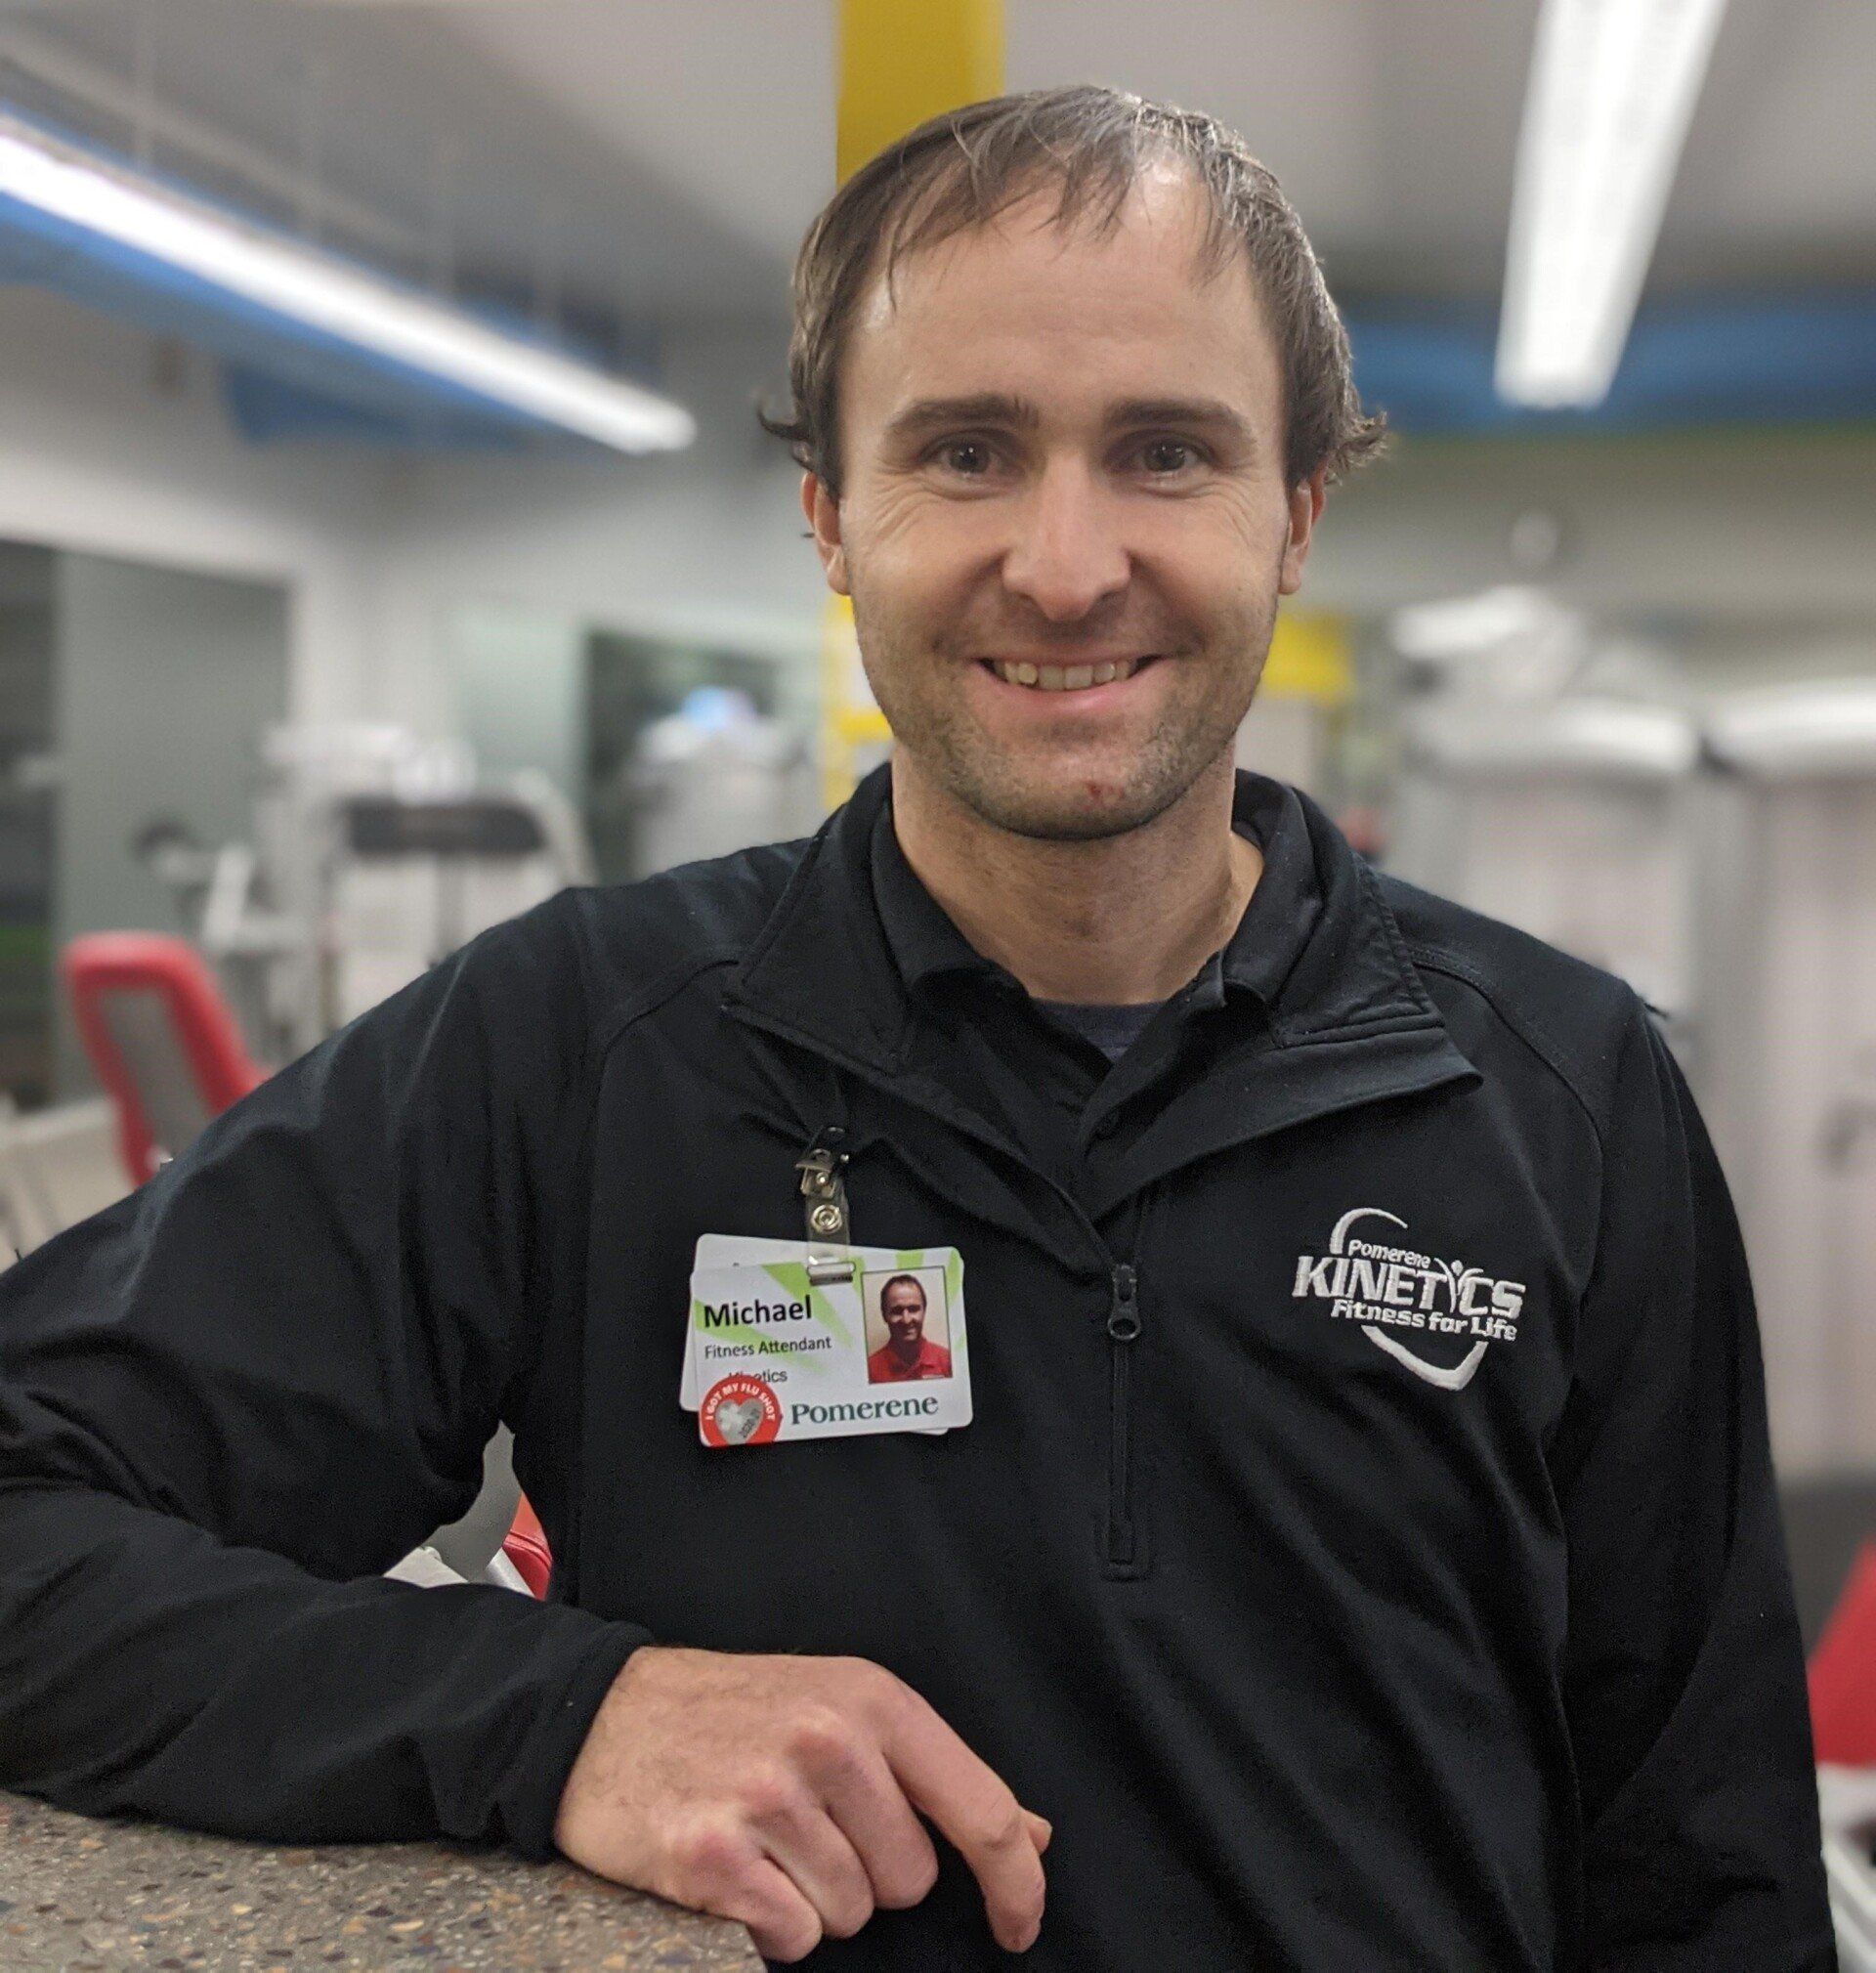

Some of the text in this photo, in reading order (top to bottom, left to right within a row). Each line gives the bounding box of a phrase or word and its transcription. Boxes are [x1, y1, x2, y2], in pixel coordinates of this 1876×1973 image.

[1348, 1239, 1431, 1268] Pomerene
[704, 1294, 812, 1328] Michael
[1331, 1300, 1517, 1341] Fitness for Life
[704, 1336, 832, 1359] Fitness Attendant
[728, 1369, 788, 1383] etics
[706, 1391, 722, 1414] GOT
[722, 1383, 739, 1395] MY
[740, 1383, 760, 1395] FLU
[758, 1392, 776, 1421] SHOT
[791, 1395, 939, 1425] Pomerene
